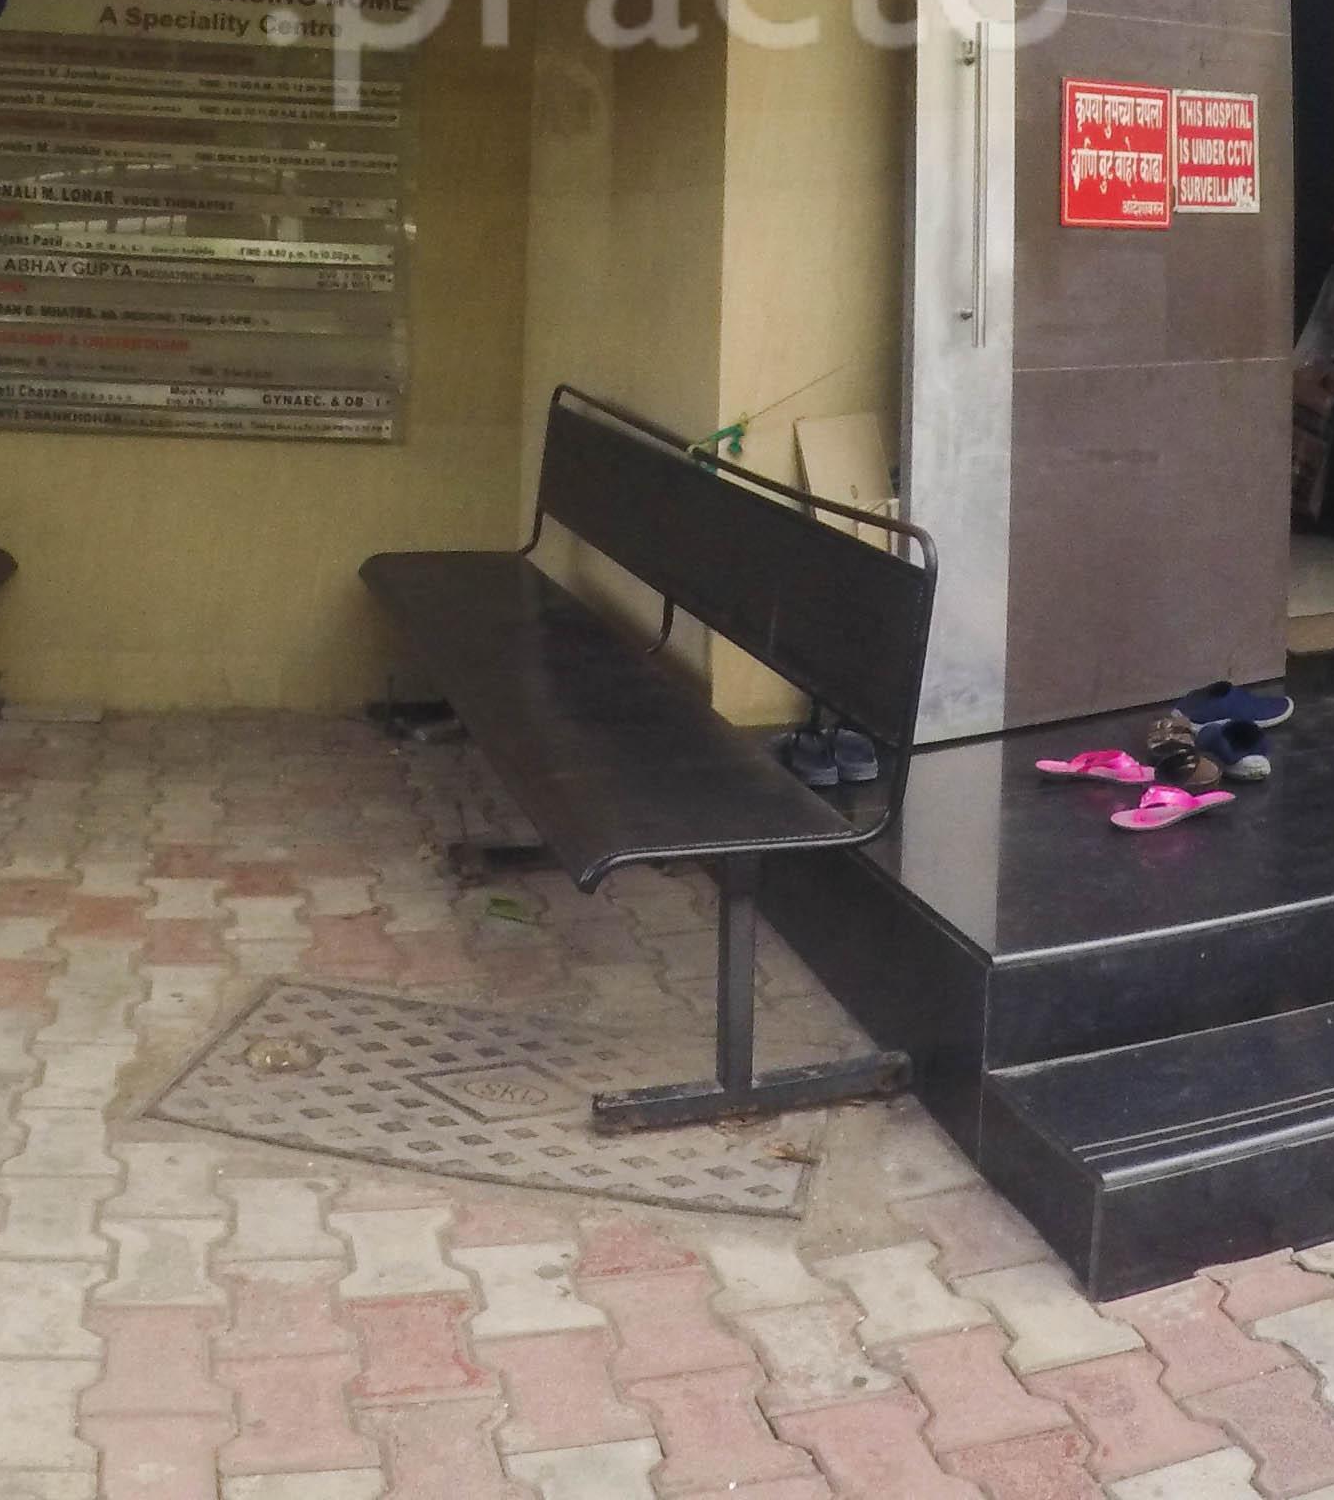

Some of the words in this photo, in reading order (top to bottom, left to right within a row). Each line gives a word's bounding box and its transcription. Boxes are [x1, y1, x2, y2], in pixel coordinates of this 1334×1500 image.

[99, 5, 118, 27] A
[126, 6, 251, 39] Speciality
[259, 13, 343, 40] Centre
[1179, 99, 1203, 127] THIS
[1205, 100, 1252, 129] HOSPITAL
[1179, 137, 1189, 164] IS
[1191, 138, 1225, 165] UNDER
[1227, 139, 1253, 166] CCTV
[1180, 175, 1253, 203] SURVEILLANCE
[4, 257, 67, 276] ABHAY
[71, 259, 133, 277] GUPTA
